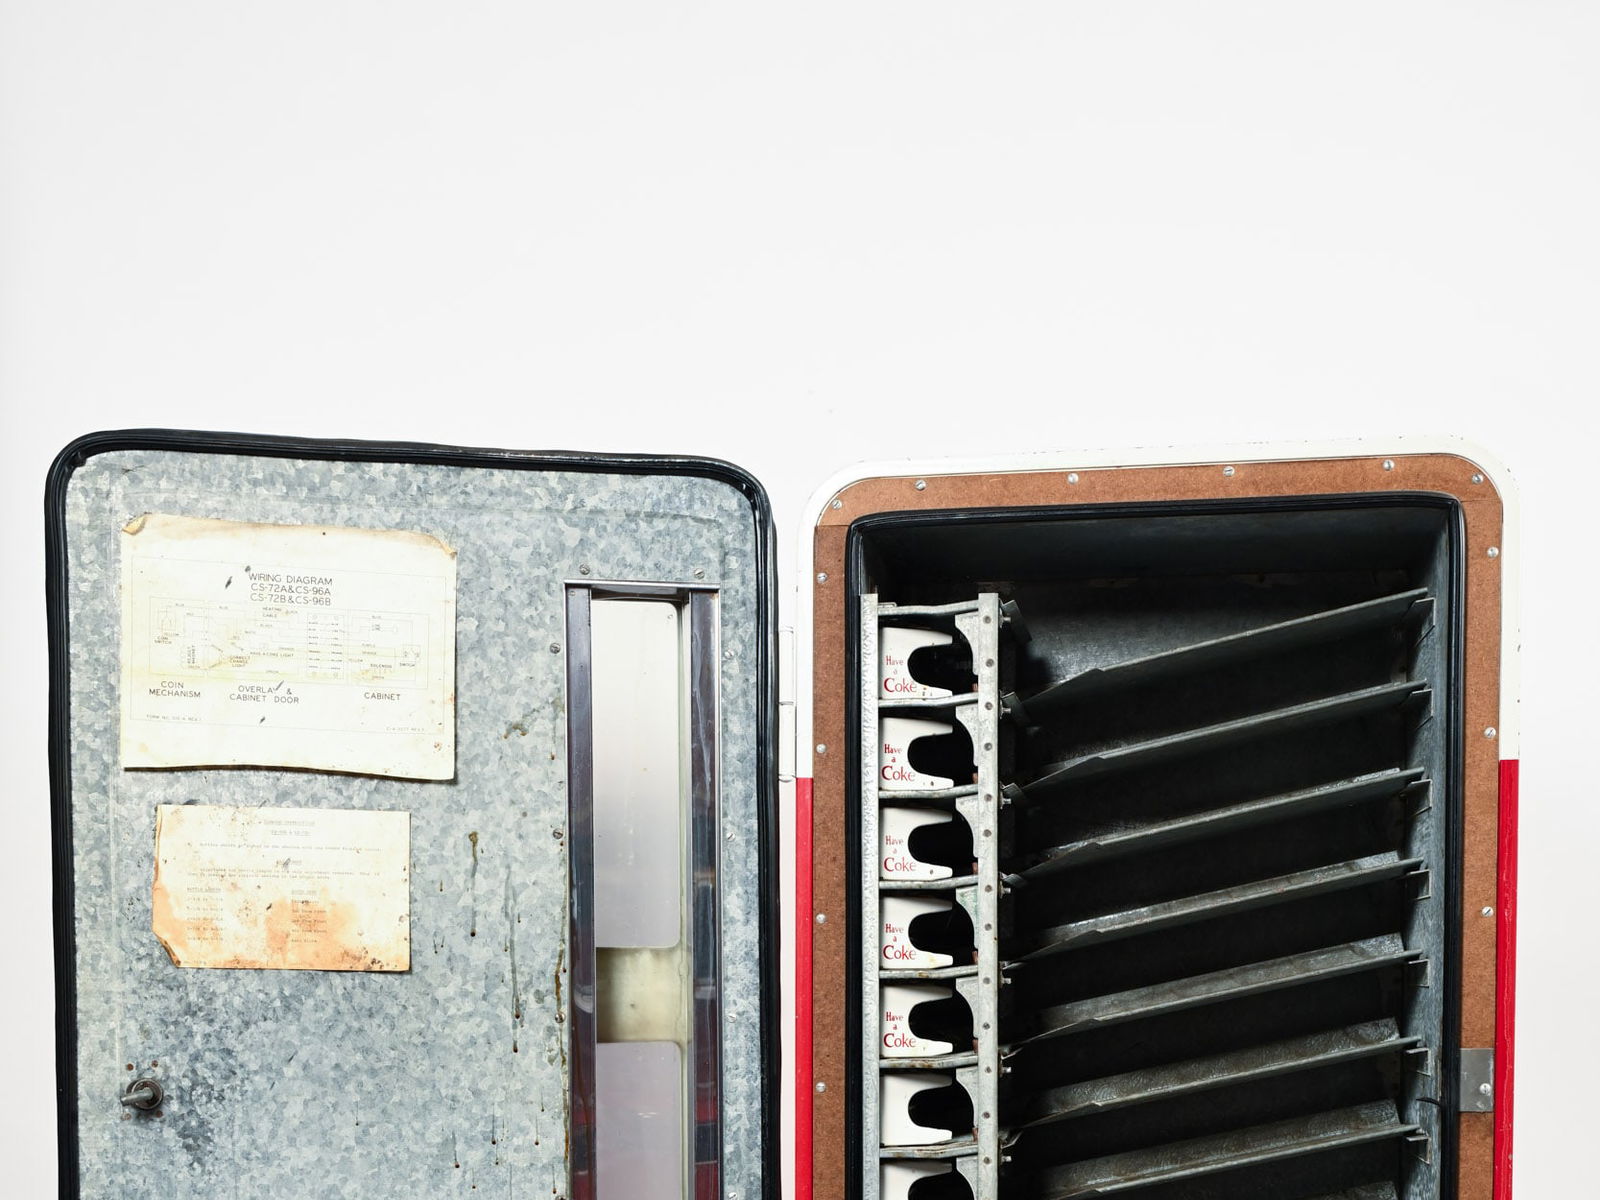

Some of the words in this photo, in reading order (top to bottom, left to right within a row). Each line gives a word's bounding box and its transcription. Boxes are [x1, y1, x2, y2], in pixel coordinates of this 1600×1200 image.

[249, 573, 282, 583] WIRING
[286, 575, 333, 586] DIAGRAM
[885, 655, 904, 666] Have
[160, 680, 184, 689] COIN
[883, 677, 917, 693] Coke
[149, 688, 201, 698] MECHANISM
[229, 693, 267, 702] CABINET
[274, 695, 300, 704] DOOR
[364, 692, 401, 701] CABINET
[884, 744, 902, 755] Have
[881, 765, 917, 781] Coke
[885, 835, 904, 846] Have
[883, 856, 917, 872] Coke
[885, 923, 904, 934] Have
[883, 945, 917, 960] Coke
[885, 1011, 903, 1022] Have
[883, 1032, 917, 1048] Coke
